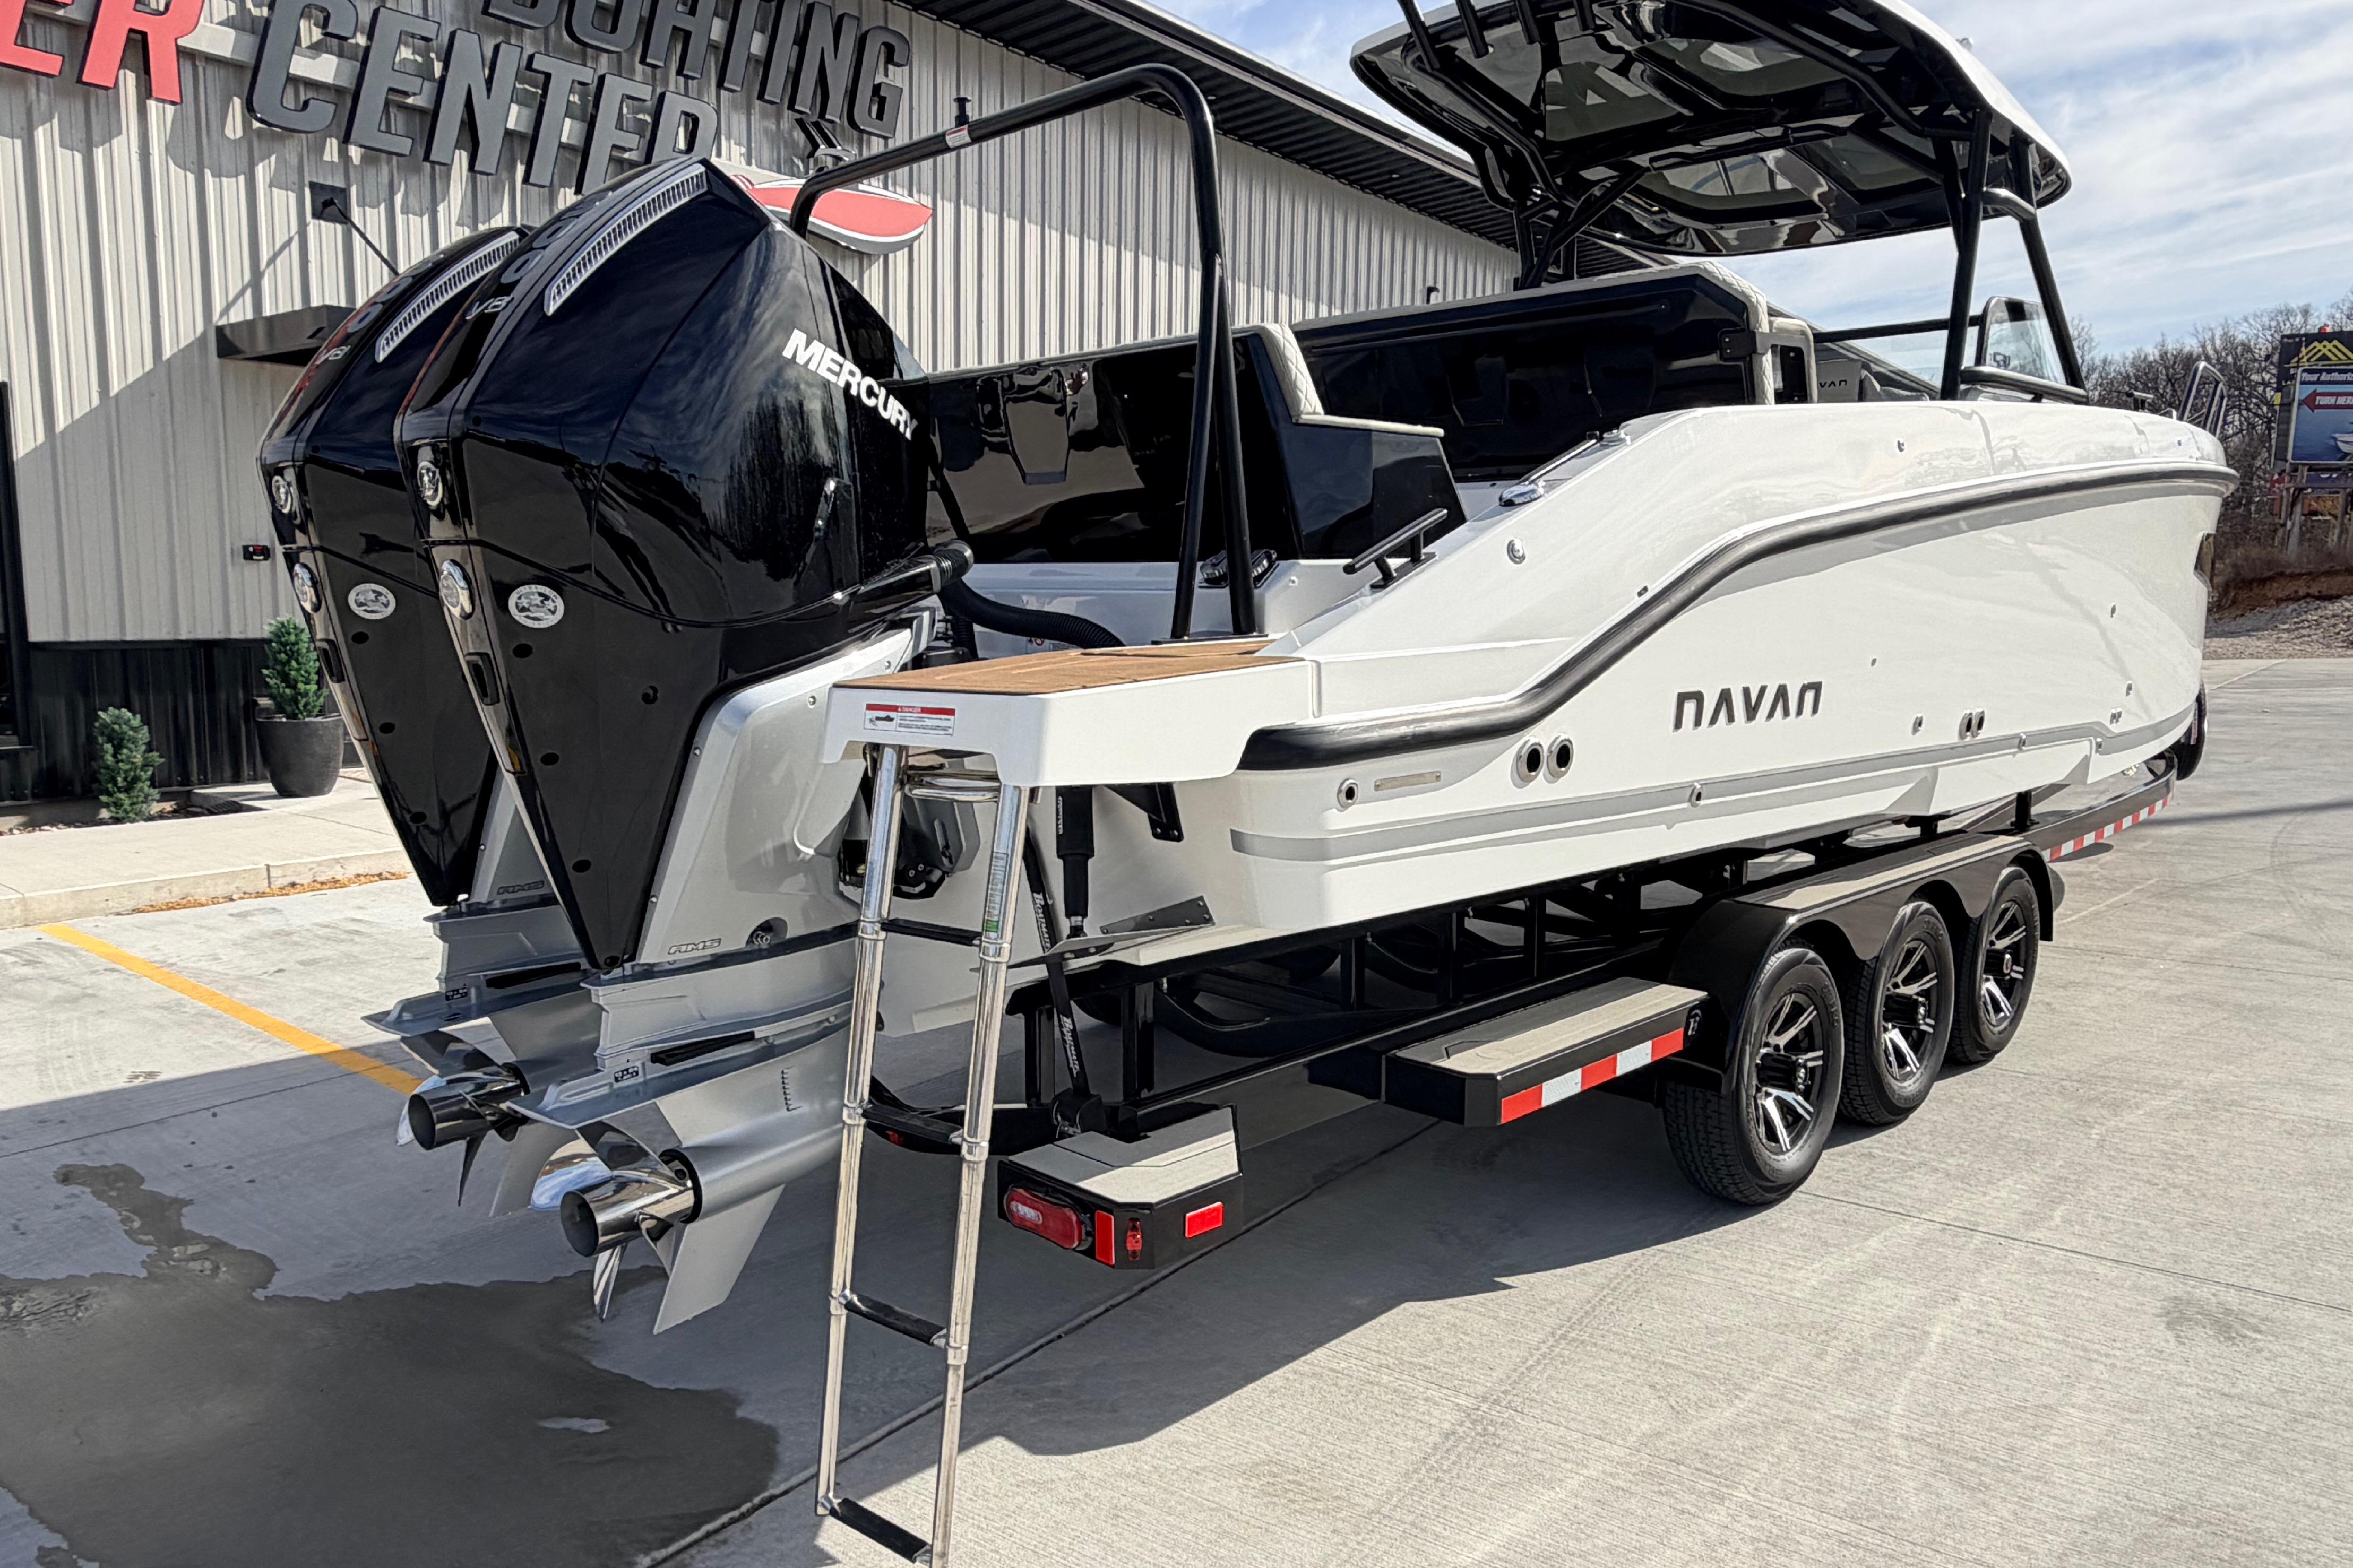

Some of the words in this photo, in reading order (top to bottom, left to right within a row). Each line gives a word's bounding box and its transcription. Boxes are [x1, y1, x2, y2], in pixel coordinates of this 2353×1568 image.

[466, 294, 514, 319] V8
[782, 328, 918, 441] MERCURY
[1673, 681, 1822, 732] NAVAN
